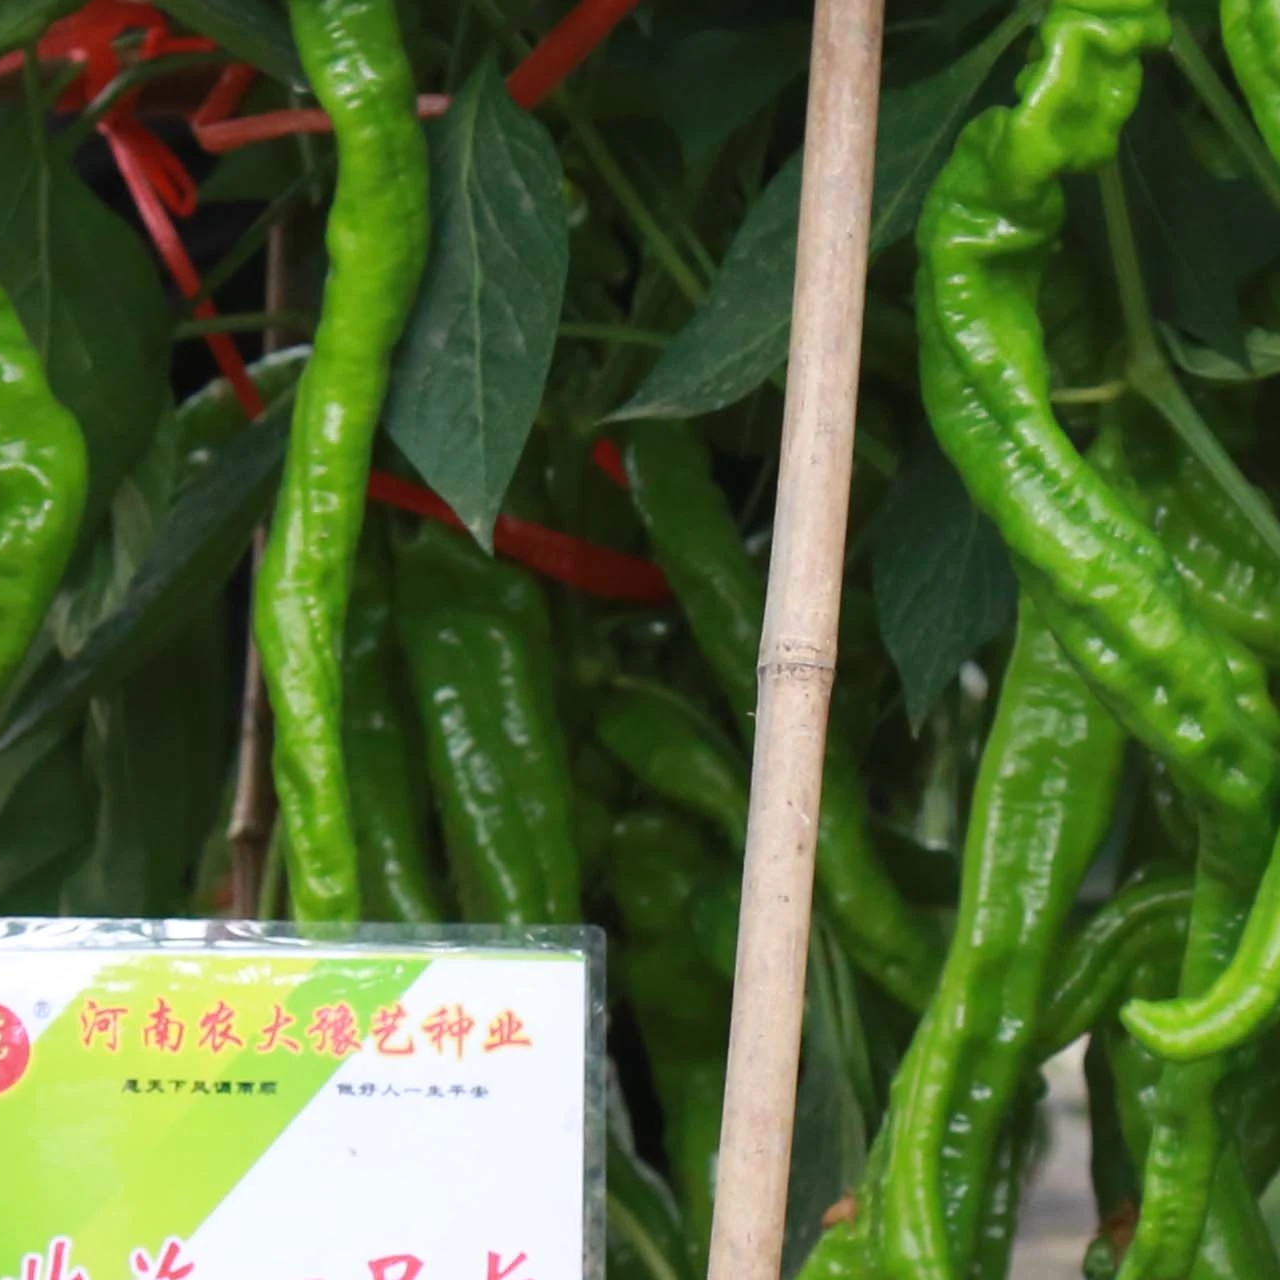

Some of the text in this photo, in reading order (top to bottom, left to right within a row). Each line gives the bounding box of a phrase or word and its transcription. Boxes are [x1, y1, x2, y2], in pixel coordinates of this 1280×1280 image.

[80, 997, 532, 1059] 河南农大豫艺种业
[336, 1081, 490, 1100] 做好人一生平安
